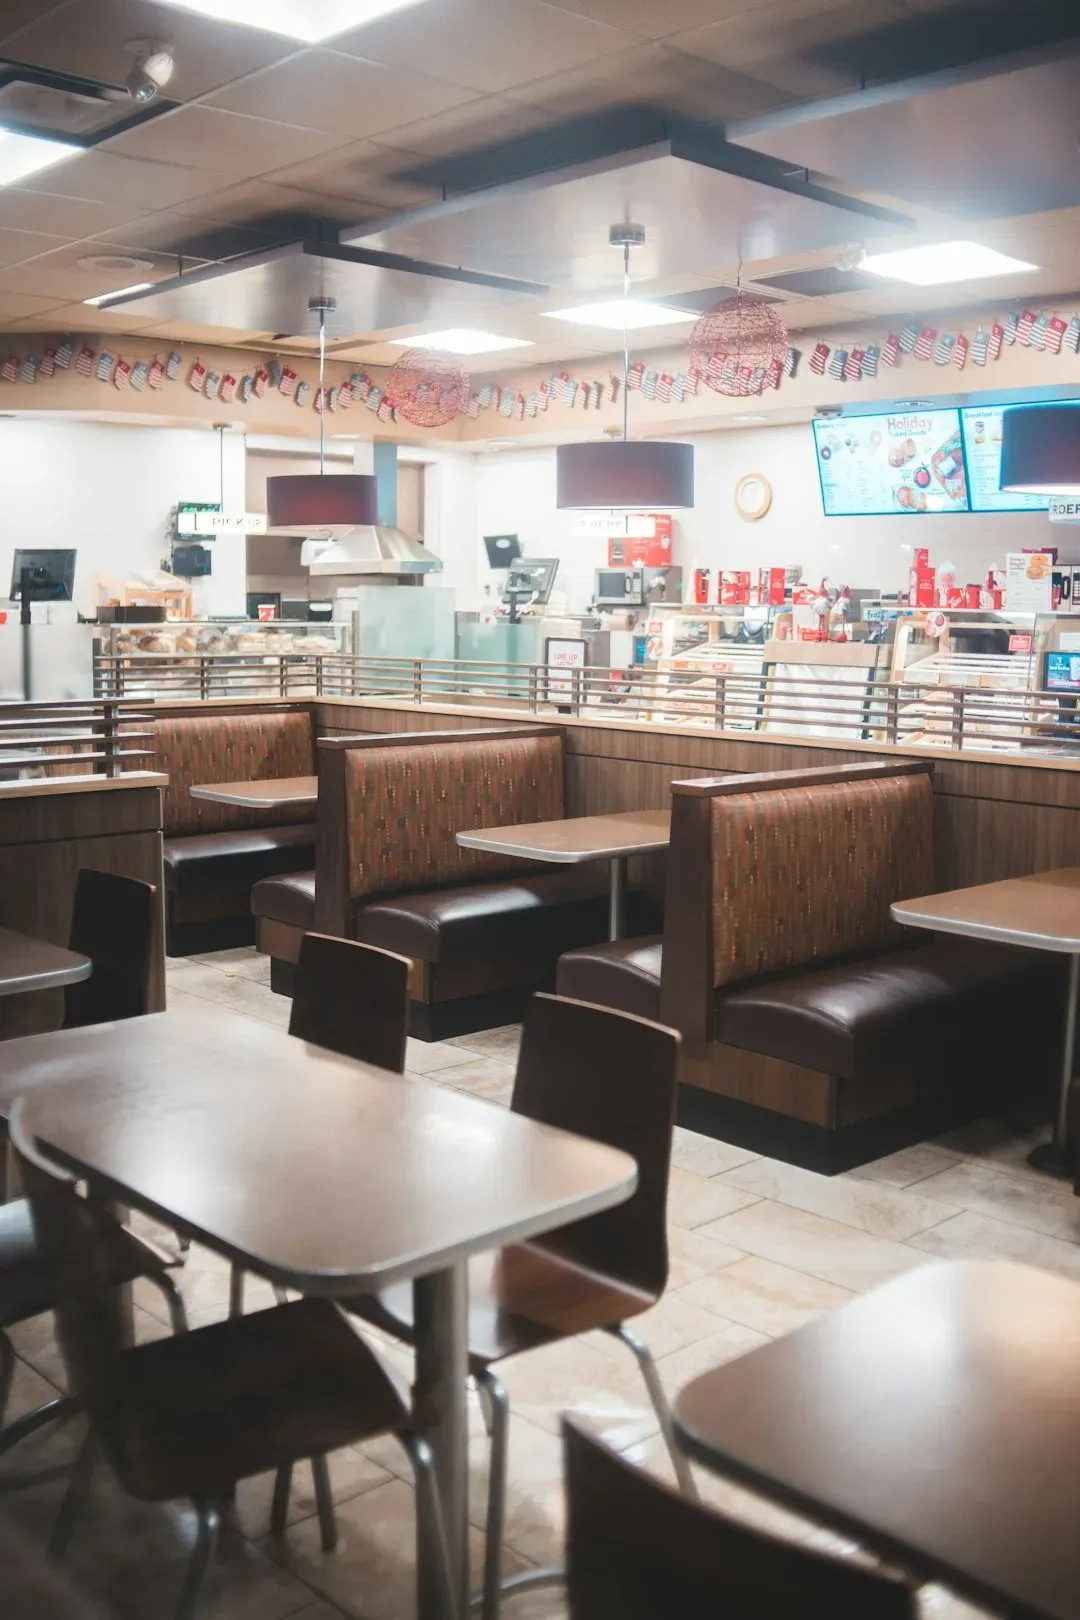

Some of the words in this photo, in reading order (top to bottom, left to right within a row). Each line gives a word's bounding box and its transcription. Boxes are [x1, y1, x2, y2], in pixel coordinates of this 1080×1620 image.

[887, 415, 934, 432] Holiday
[212, 518, 245, 528] PICK
[553, 653, 568, 661] LINE
[569, 653, 579, 662] UP
